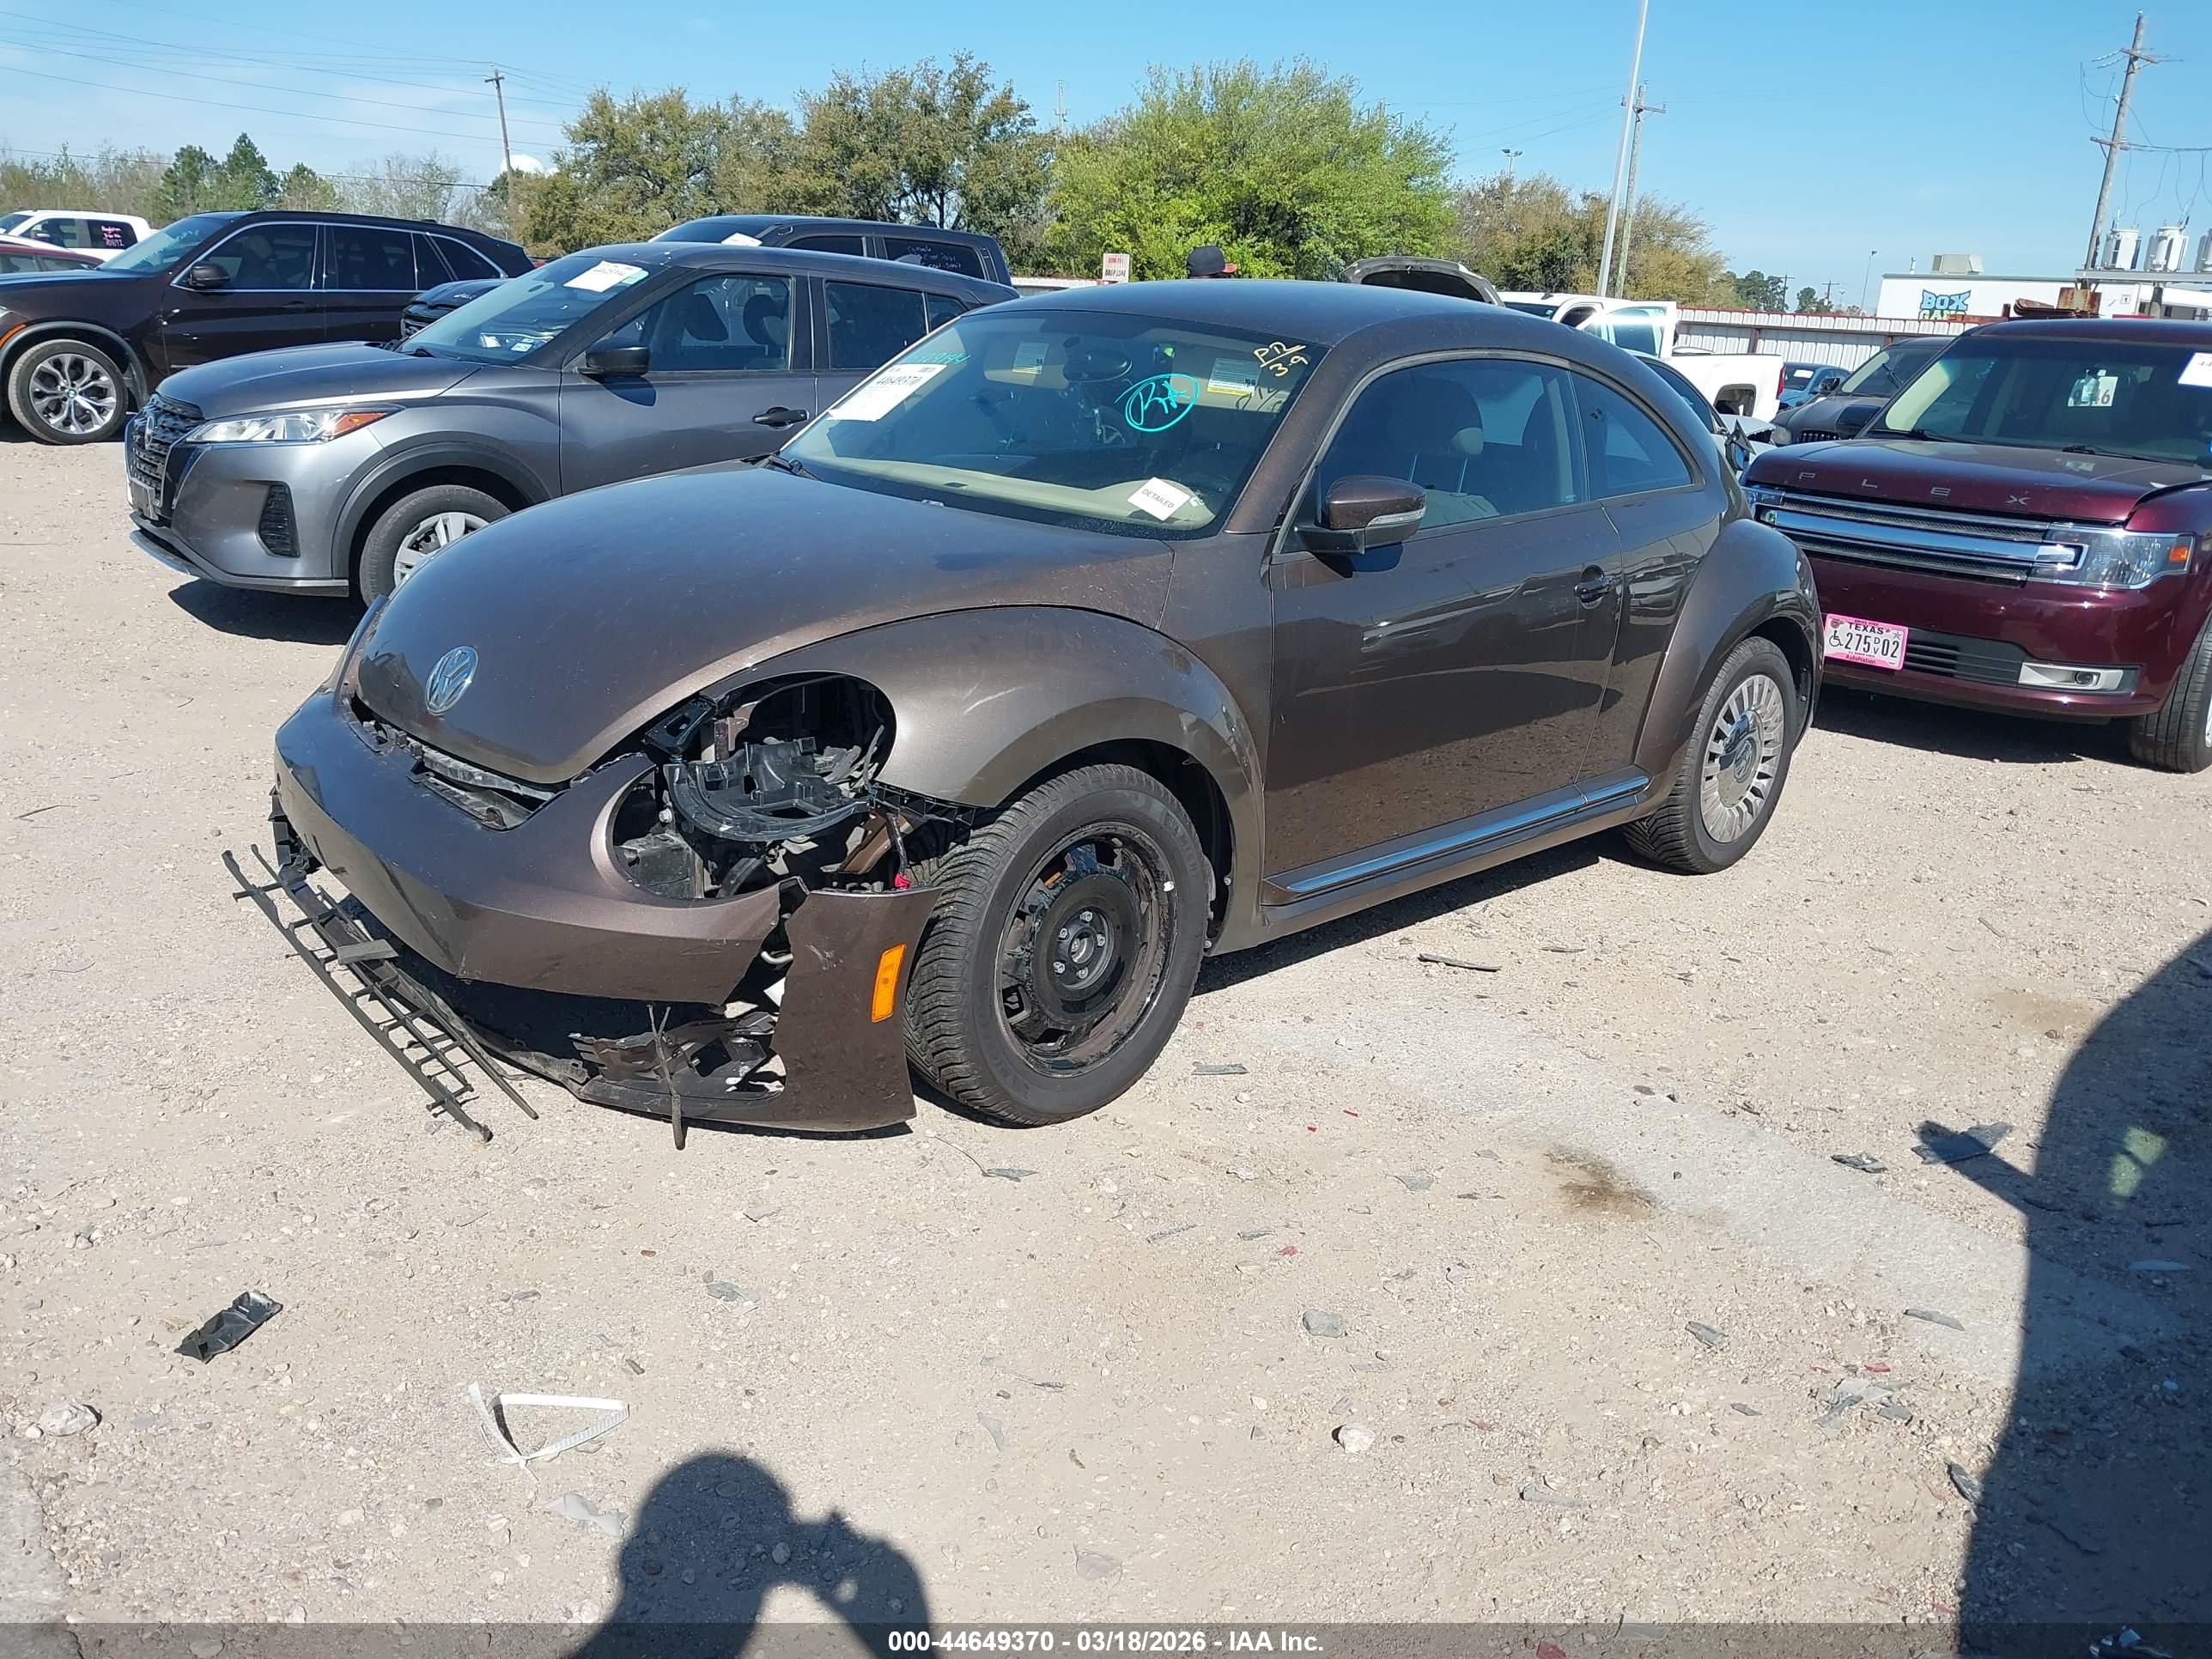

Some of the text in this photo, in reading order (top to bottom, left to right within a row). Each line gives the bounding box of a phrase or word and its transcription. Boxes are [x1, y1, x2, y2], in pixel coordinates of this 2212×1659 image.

[1920, 289, 1972, 311] BOX
[1141, 489, 1175, 508] DETAILED
[1847, 622, 1884, 635] TEXAS
[1845, 654, 1876, 665] AutoNation
